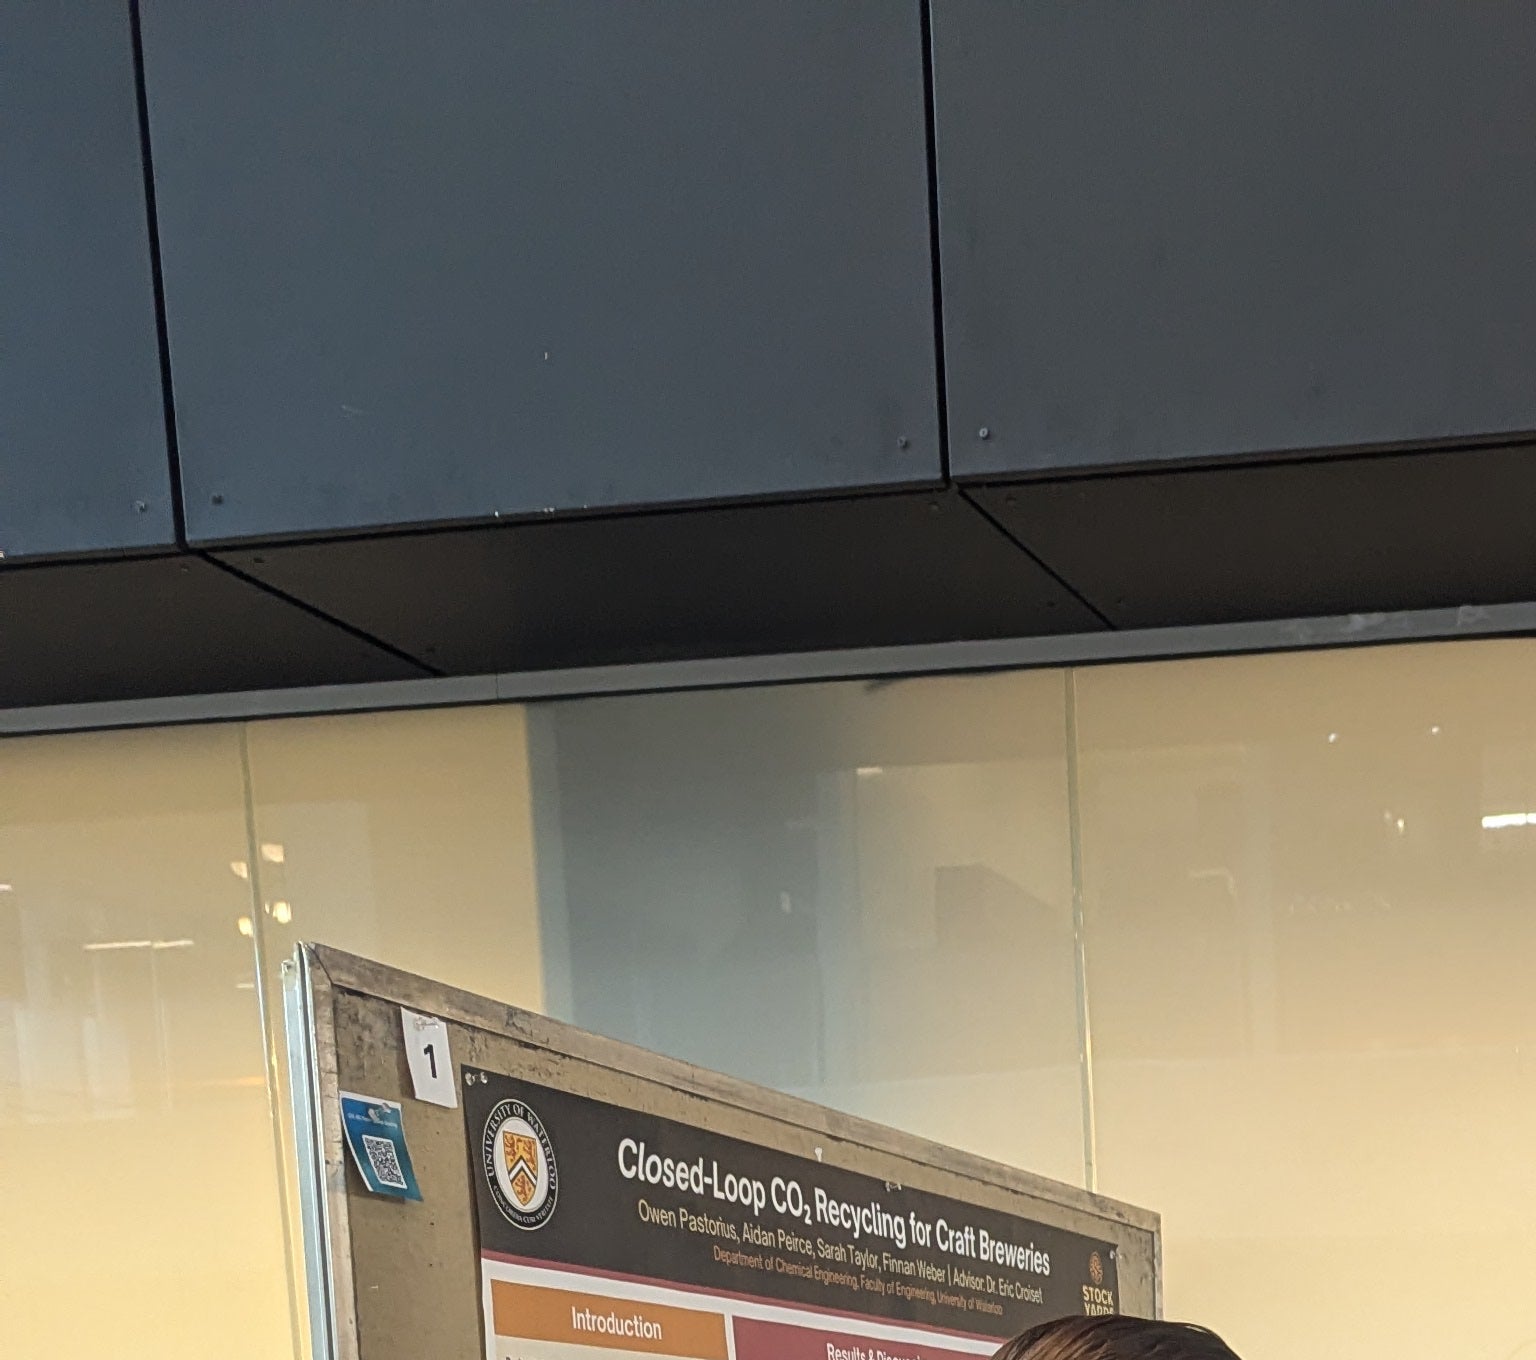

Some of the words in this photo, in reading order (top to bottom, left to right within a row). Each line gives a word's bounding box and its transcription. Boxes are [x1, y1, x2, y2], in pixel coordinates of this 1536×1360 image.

[423, 1044, 437, 1079] 1
[485, 1103, 512, 1178] UNIVERSITY
[512, 1104, 525, 1118] OF
[527, 1111, 557, 1191] WATERLOO
[618, 1137, 766, 1216] Closed-Loop
[815, 1187, 906, 1249] Recycling
[909, 1211, 932, 1248] for
[936, 1219, 977, 1259] Craft
[979, 1230, 1051, 1276] Breweries
[638, 1199, 677, 1228] Owen
[679, 1208, 741, 1244] Pastorius,
[742, 1222, 775, 1248] Aidan
[777, 1228, 816, 1260] Peirce,
[816, 1238, 847, 1263] Sarah
[847, 1245, 882, 1273] Taylor,
[882, 1254, 916, 1277] Finnan
[917, 1260, 946, 1283] Weber
[999, 1278, 1015, 1298] Eric
[1015, 1282, 1044, 1305] Croiset
[713, 1245, 764, 1271] Department
[775, 1257, 813, 1280] Chemical
[860, 1275, 885, 1297] Faculty
[1082, 1285, 1114, 1306] STOCK
[571, 1306, 663, 1340] Introduction
